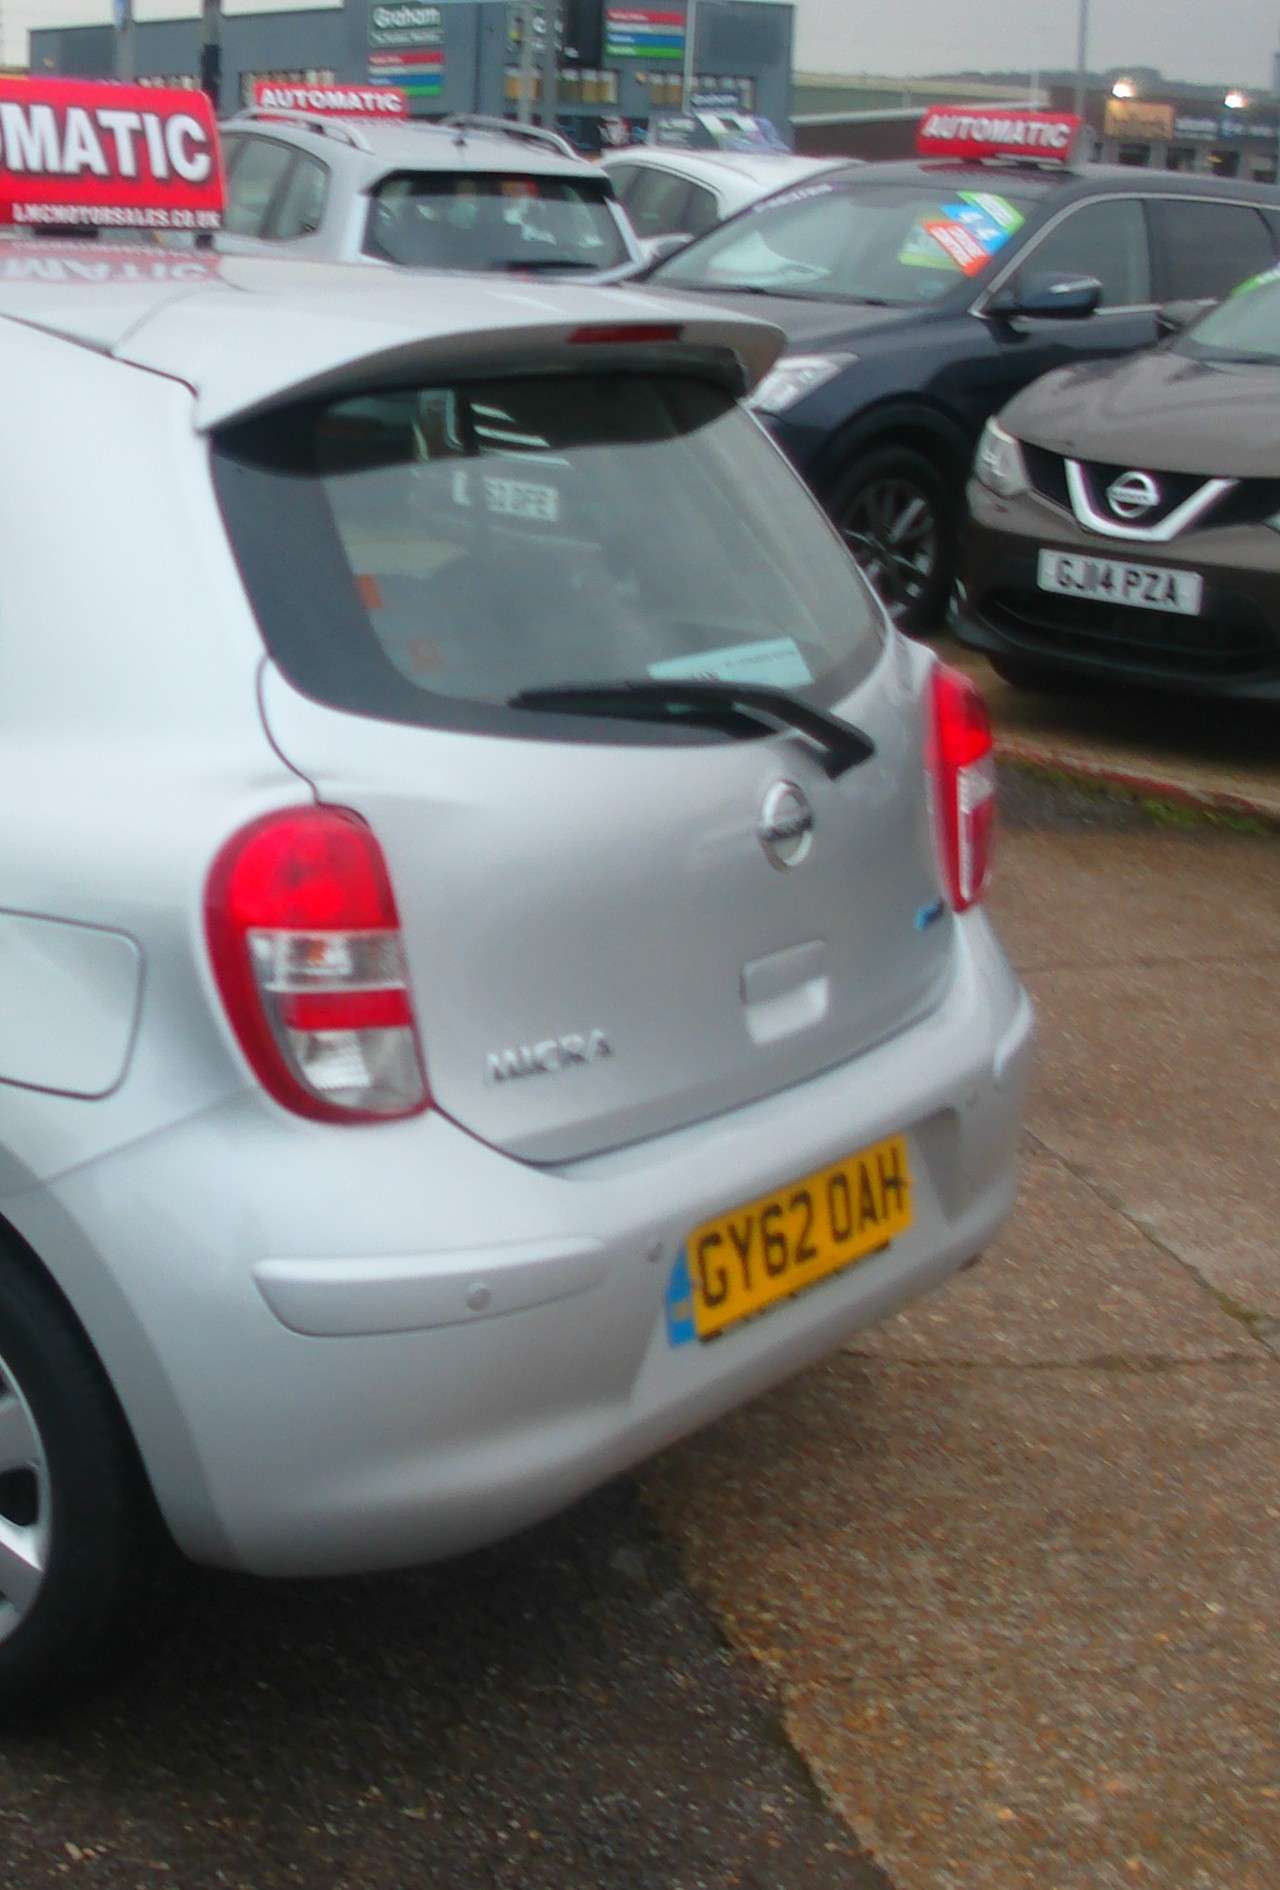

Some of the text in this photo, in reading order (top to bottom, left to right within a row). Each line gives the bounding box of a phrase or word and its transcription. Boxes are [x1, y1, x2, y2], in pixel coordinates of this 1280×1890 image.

[373, 6, 441, 28] Graham
[261, 88, 403, 112] AUTOMATIC
[923, 114, 1071, 148] AUTOMATIC
[1056, 559, 1180, 605] GJ14 PZA
[484, 1028, 612, 1084] MICRA
[696, 1146, 904, 1310] GY62 OAH
